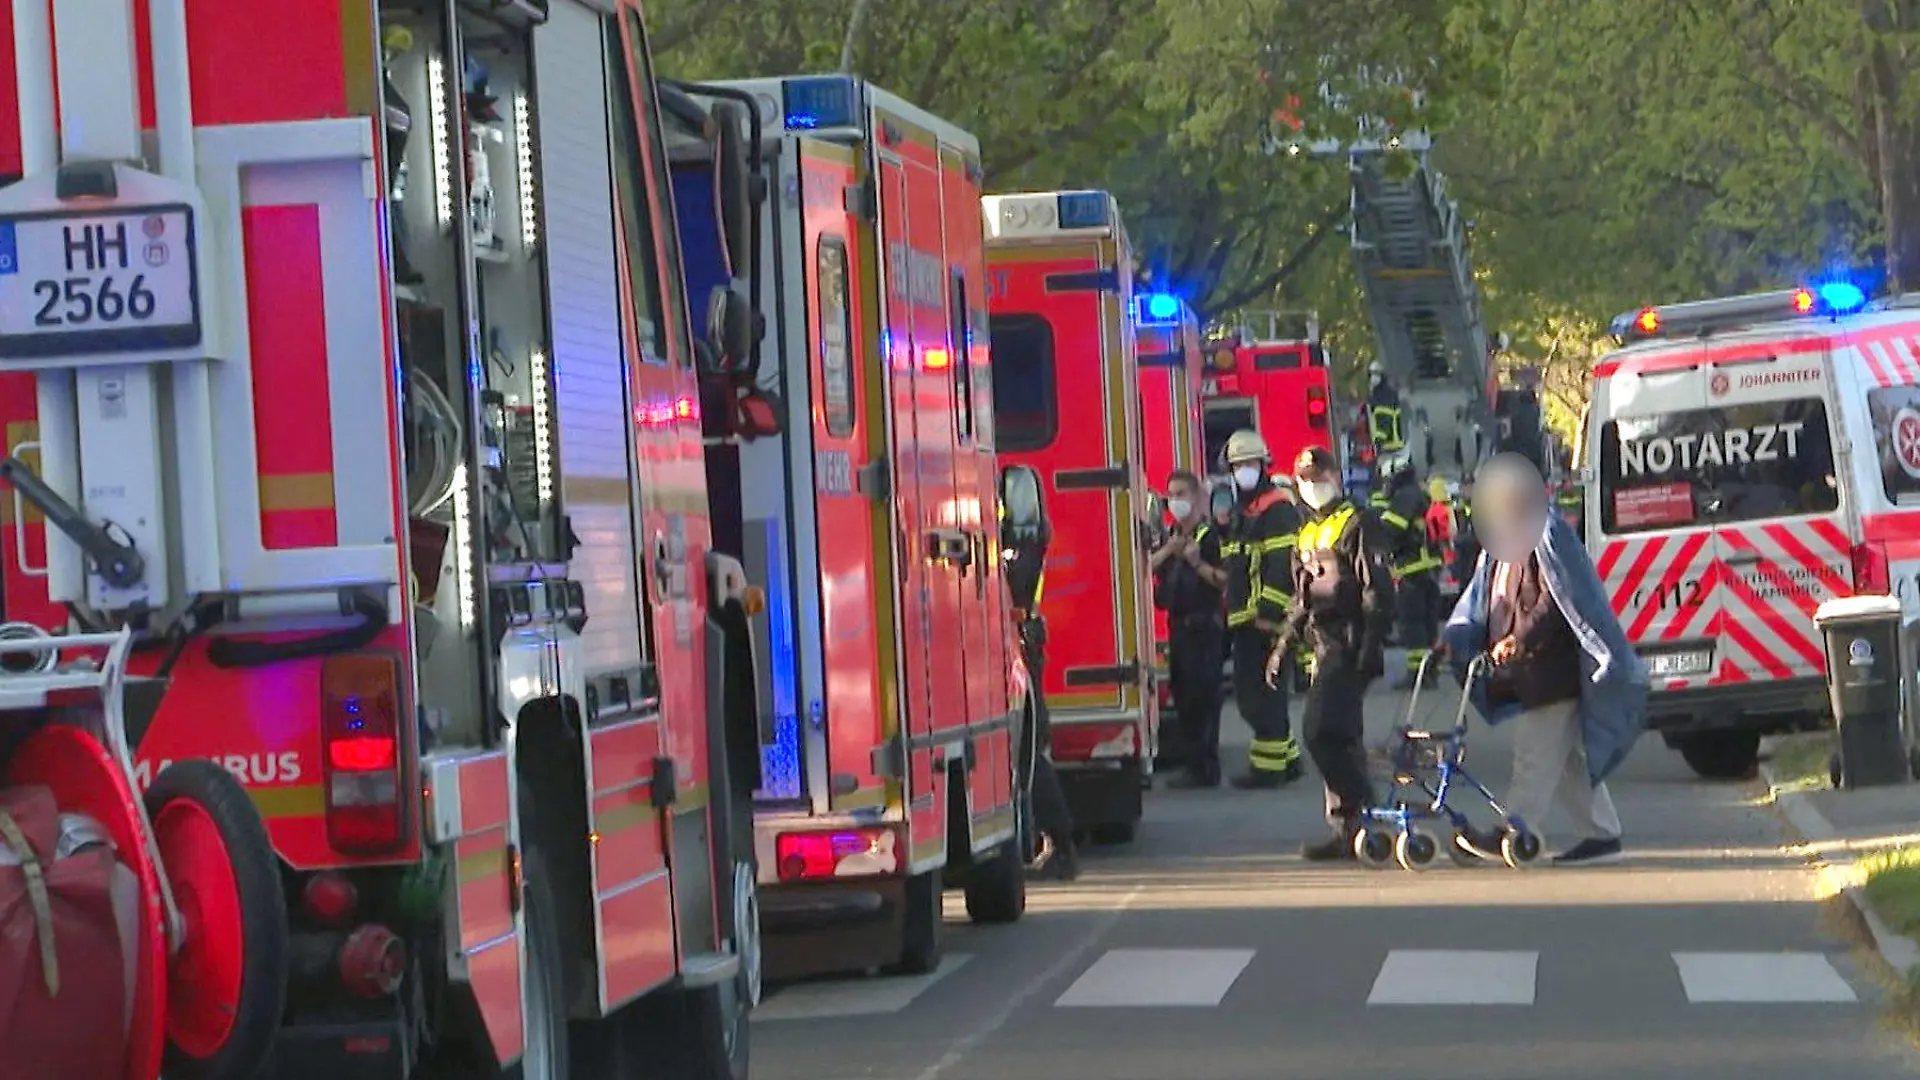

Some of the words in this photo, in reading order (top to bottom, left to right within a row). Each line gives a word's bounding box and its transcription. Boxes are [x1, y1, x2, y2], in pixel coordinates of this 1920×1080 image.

[63, 221, 128, 271] HH
[34, 274, 155, 326] 2566
[1738, 367, 1821, 389] JOHANNITER
[1619, 422, 1804, 477] NOTARZT
[815, 450, 851, 494] WEHR
[1655, 579, 1704, 610] 112
[134, 752, 301, 789] MRUS
